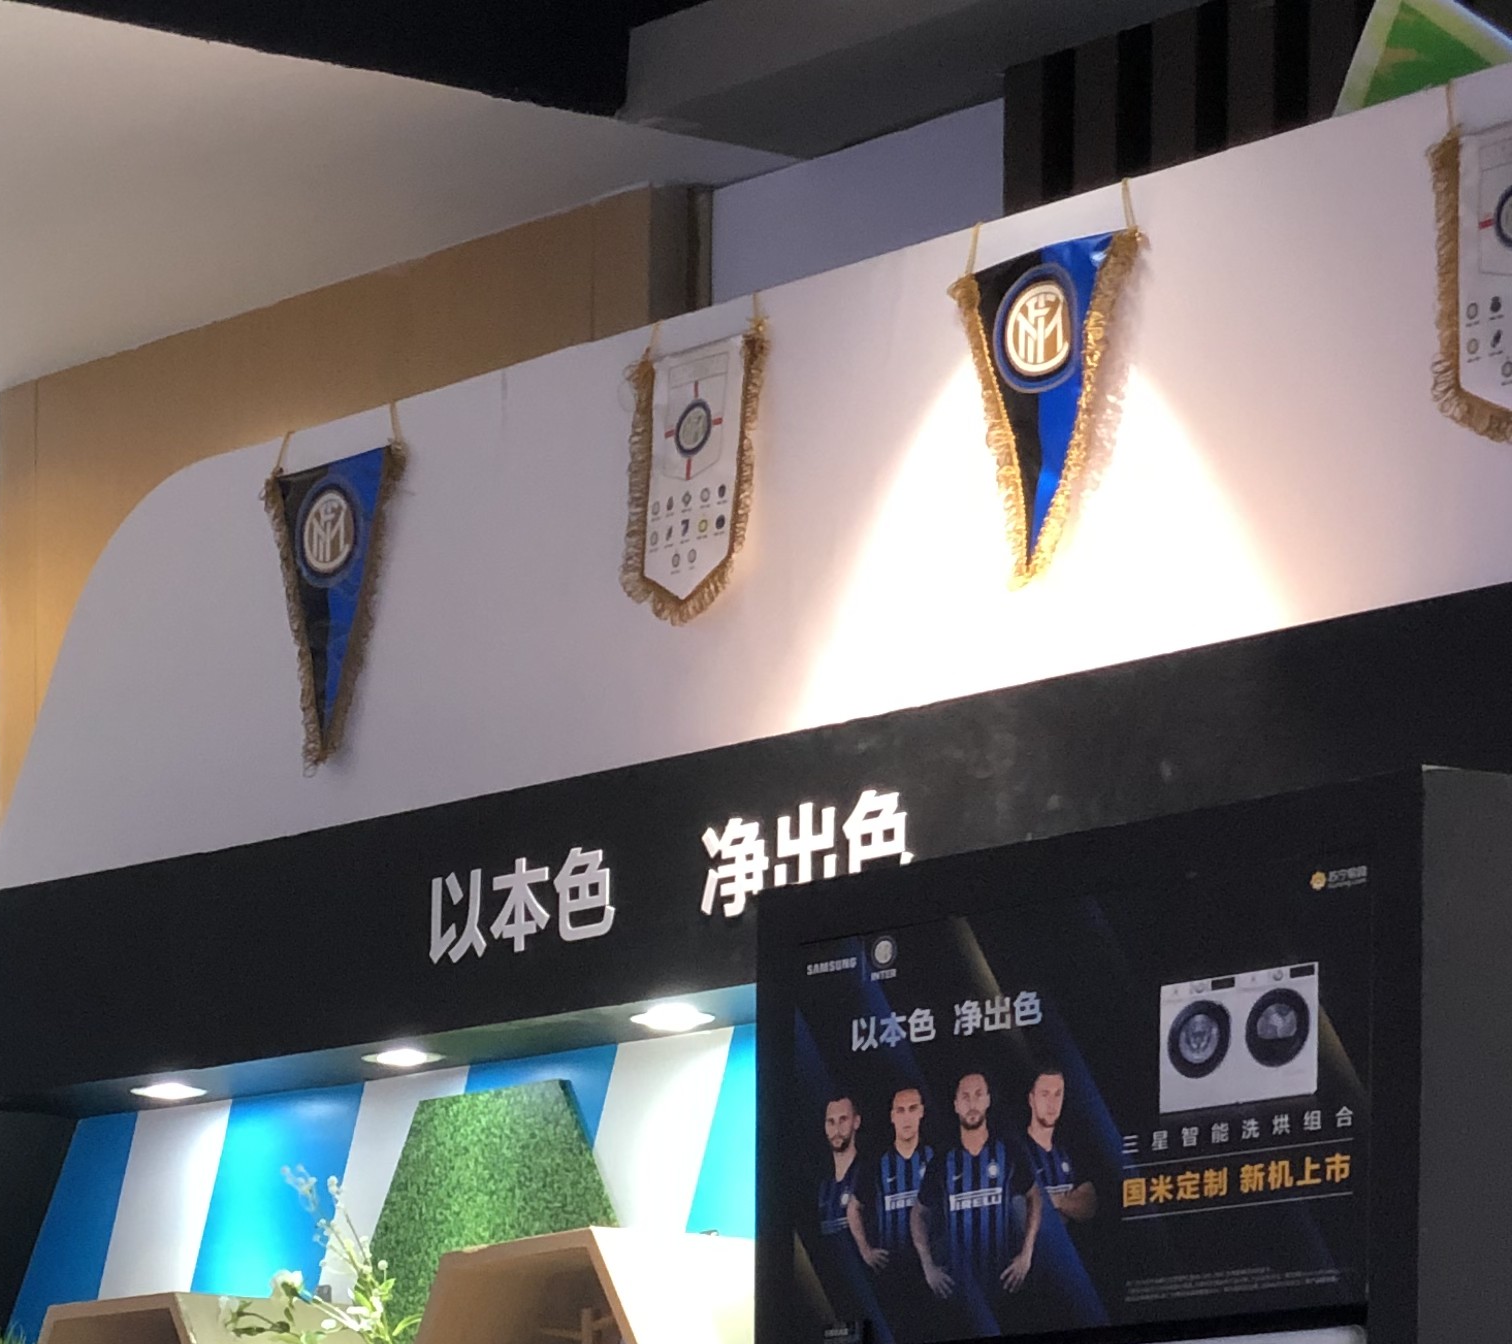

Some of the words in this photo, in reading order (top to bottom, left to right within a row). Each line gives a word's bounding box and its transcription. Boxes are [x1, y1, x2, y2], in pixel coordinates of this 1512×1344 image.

[429, 846, 615, 965] 以本色
[700, 789, 915, 918] 净出色
[806, 956, 858, 976] SAMSUNG
[851, 1008, 936, 1052] 以本色
[953, 991, 1042, 1036] 净出色
[1122, 1106, 1354, 1154] 三星智能洗烘组合
[1122, 1168, 1229, 1208] 国米定制
[1240, 1153, 1351, 1194] 新机上市
